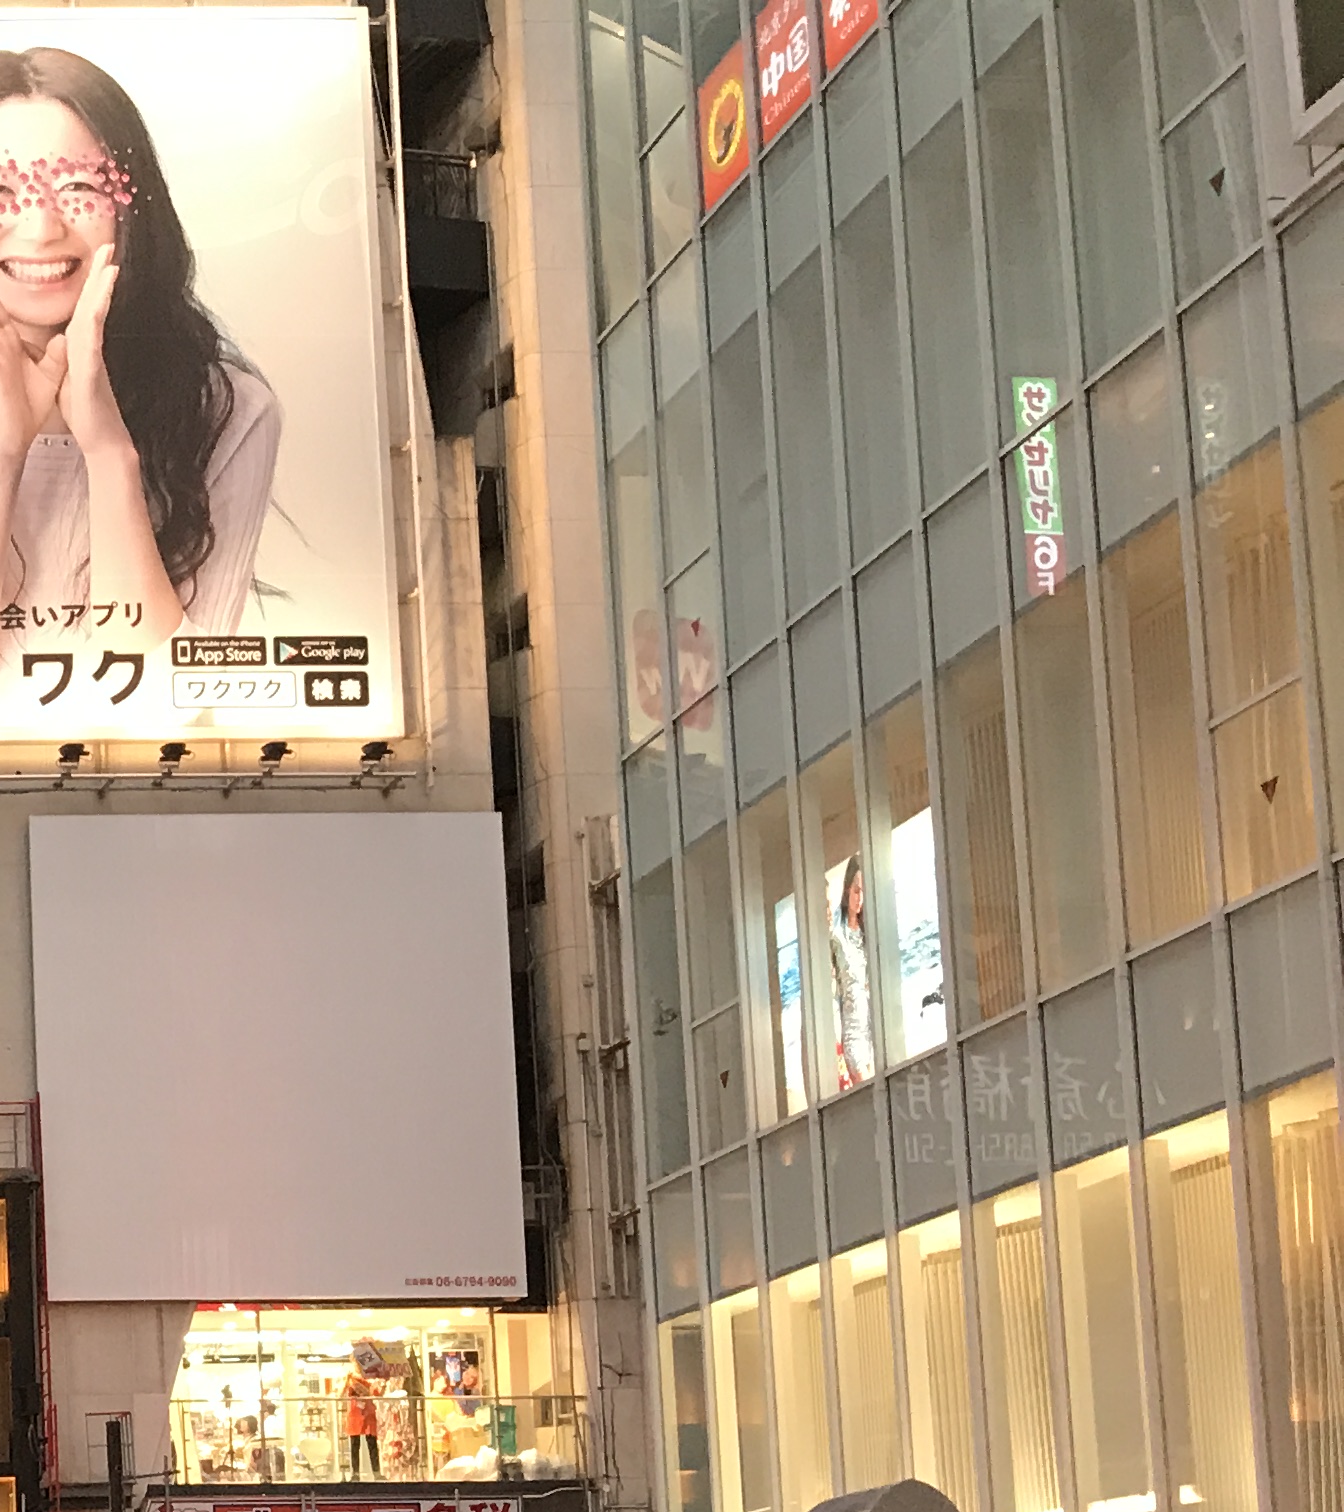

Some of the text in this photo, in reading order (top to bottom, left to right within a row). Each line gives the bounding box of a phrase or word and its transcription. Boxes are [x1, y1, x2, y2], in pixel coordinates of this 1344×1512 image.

[762, 15, 809, 98] 中国
[194, 648, 262, 665] App Store
[301, 646, 366, 661] Google play
[187, 679, 282, 700] ワクワク
